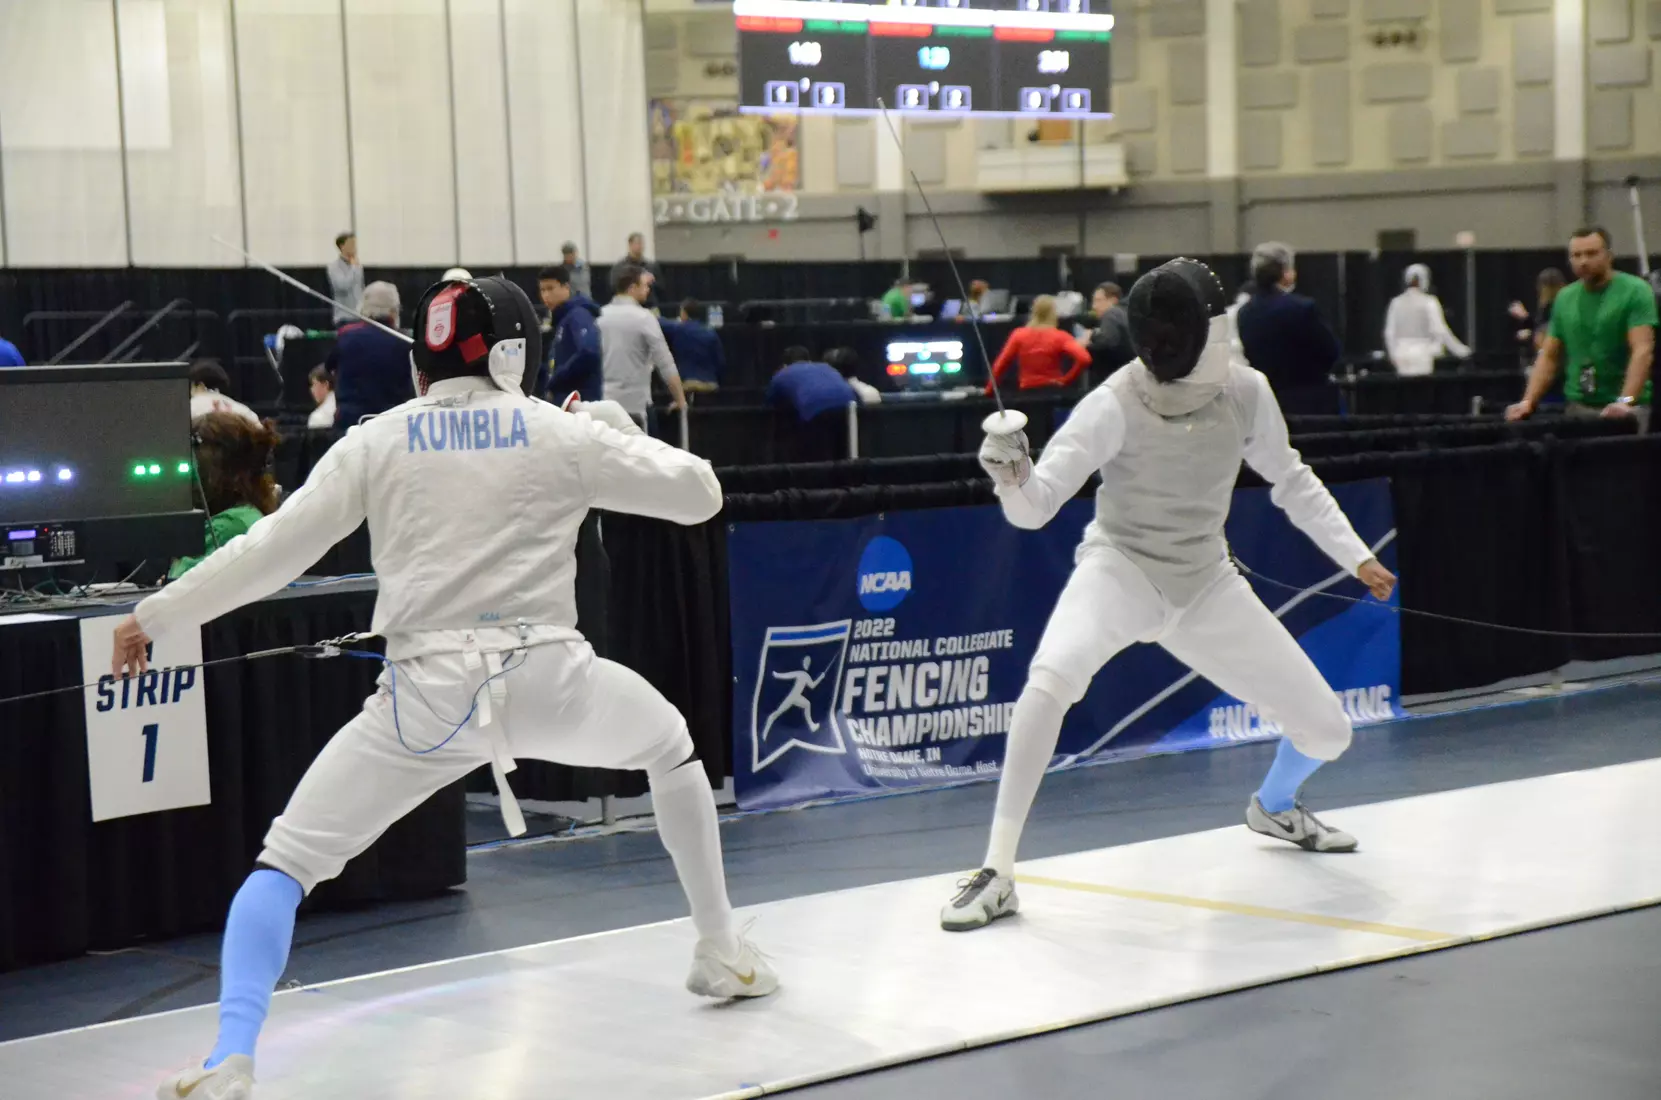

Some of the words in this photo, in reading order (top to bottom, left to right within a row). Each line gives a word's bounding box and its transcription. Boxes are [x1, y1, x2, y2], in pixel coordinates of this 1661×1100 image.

[407, 408, 529, 453] KUMBLA
[860, 571, 912, 594] NCAA
[853, 618, 896, 639] 2022
[849, 639, 931, 662] NATIONAL
[935, 629, 1014, 655] COLLEGIATE
[96, 665, 196, 712] STRIP
[842, 656, 990, 714] FENCING
[141, 723, 159, 783] 1
[857, 747, 889, 761] NOTRE
[926, 747, 941, 761] IN
[863, 763, 908, 780] University
[976, 760, 998, 774] Host
